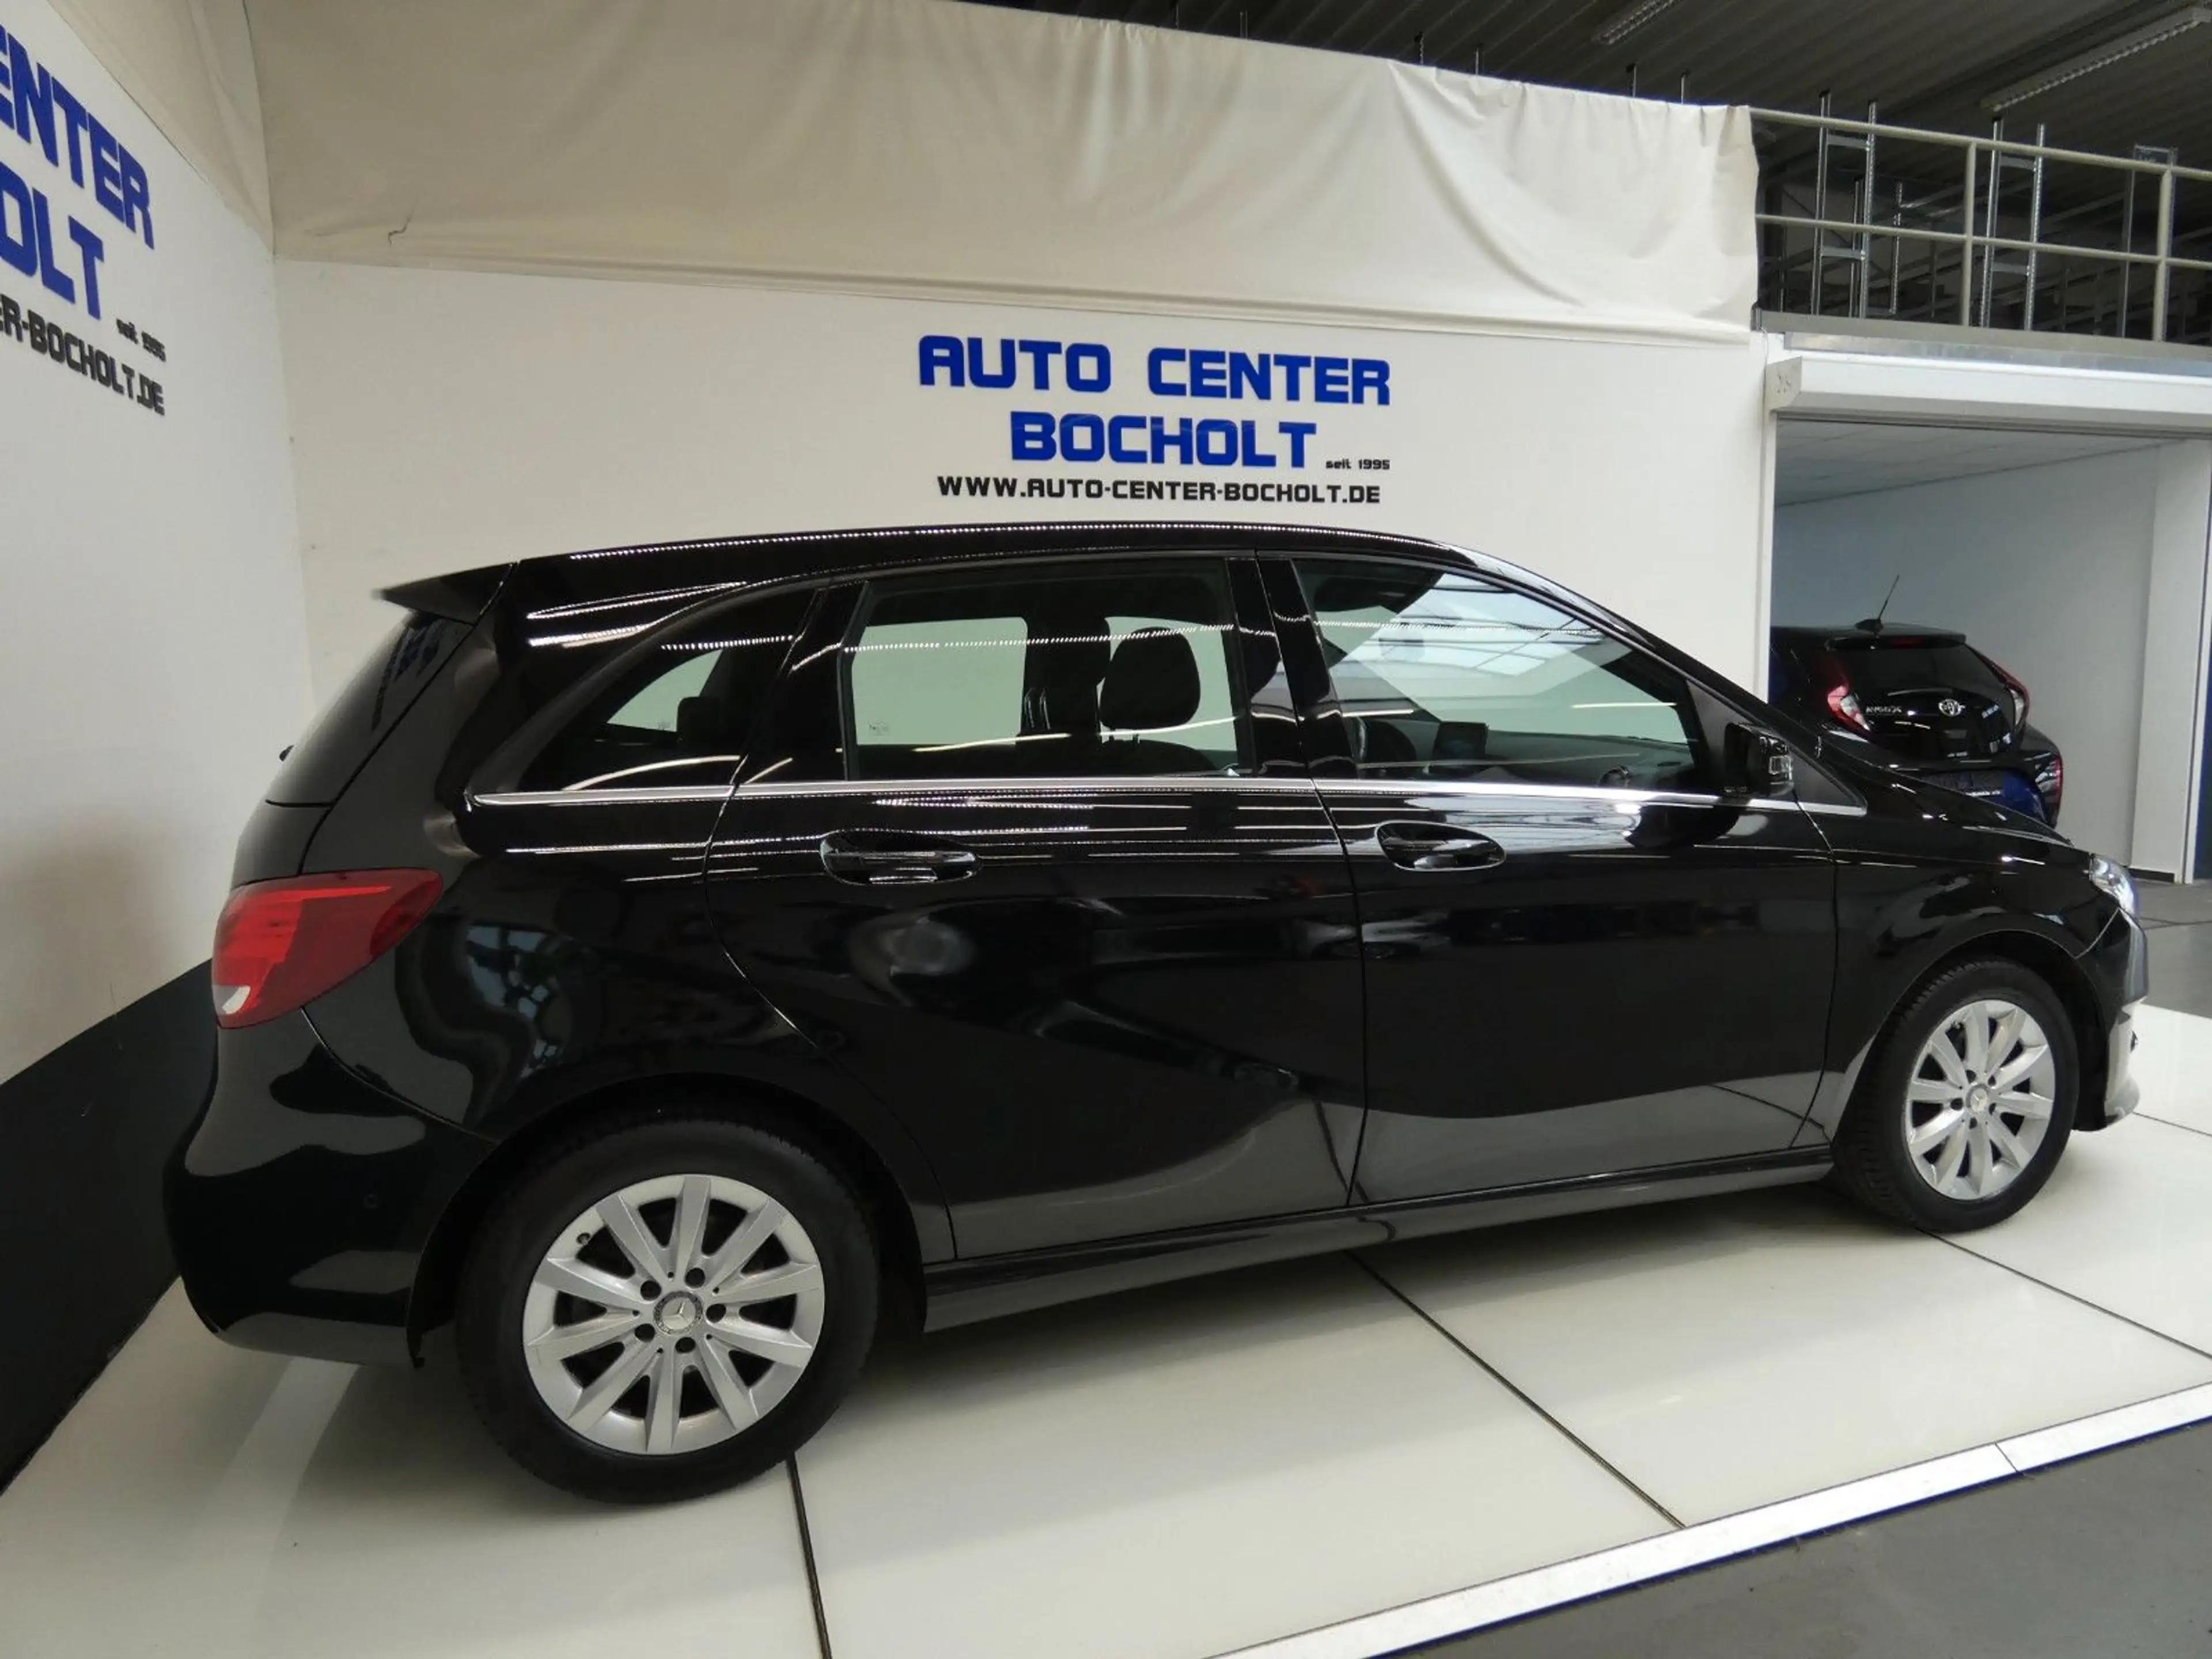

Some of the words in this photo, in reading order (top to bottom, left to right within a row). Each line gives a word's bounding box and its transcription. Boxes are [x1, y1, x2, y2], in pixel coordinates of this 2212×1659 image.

[0, 293, 165, 416] R-BOCHOLT.DE
[918, 335, 1112, 394] AUTO
[1148, 347, 1391, 406] CENTER
[1010, 411, 1317, 469] BOCHOLT
[1325, 459, 1351, 469] seit
[1358, 459, 1390, 470] 1995
[937, 475, 1380, 504] WWW.AUTO-CENTER-BOCHOLT.DE
